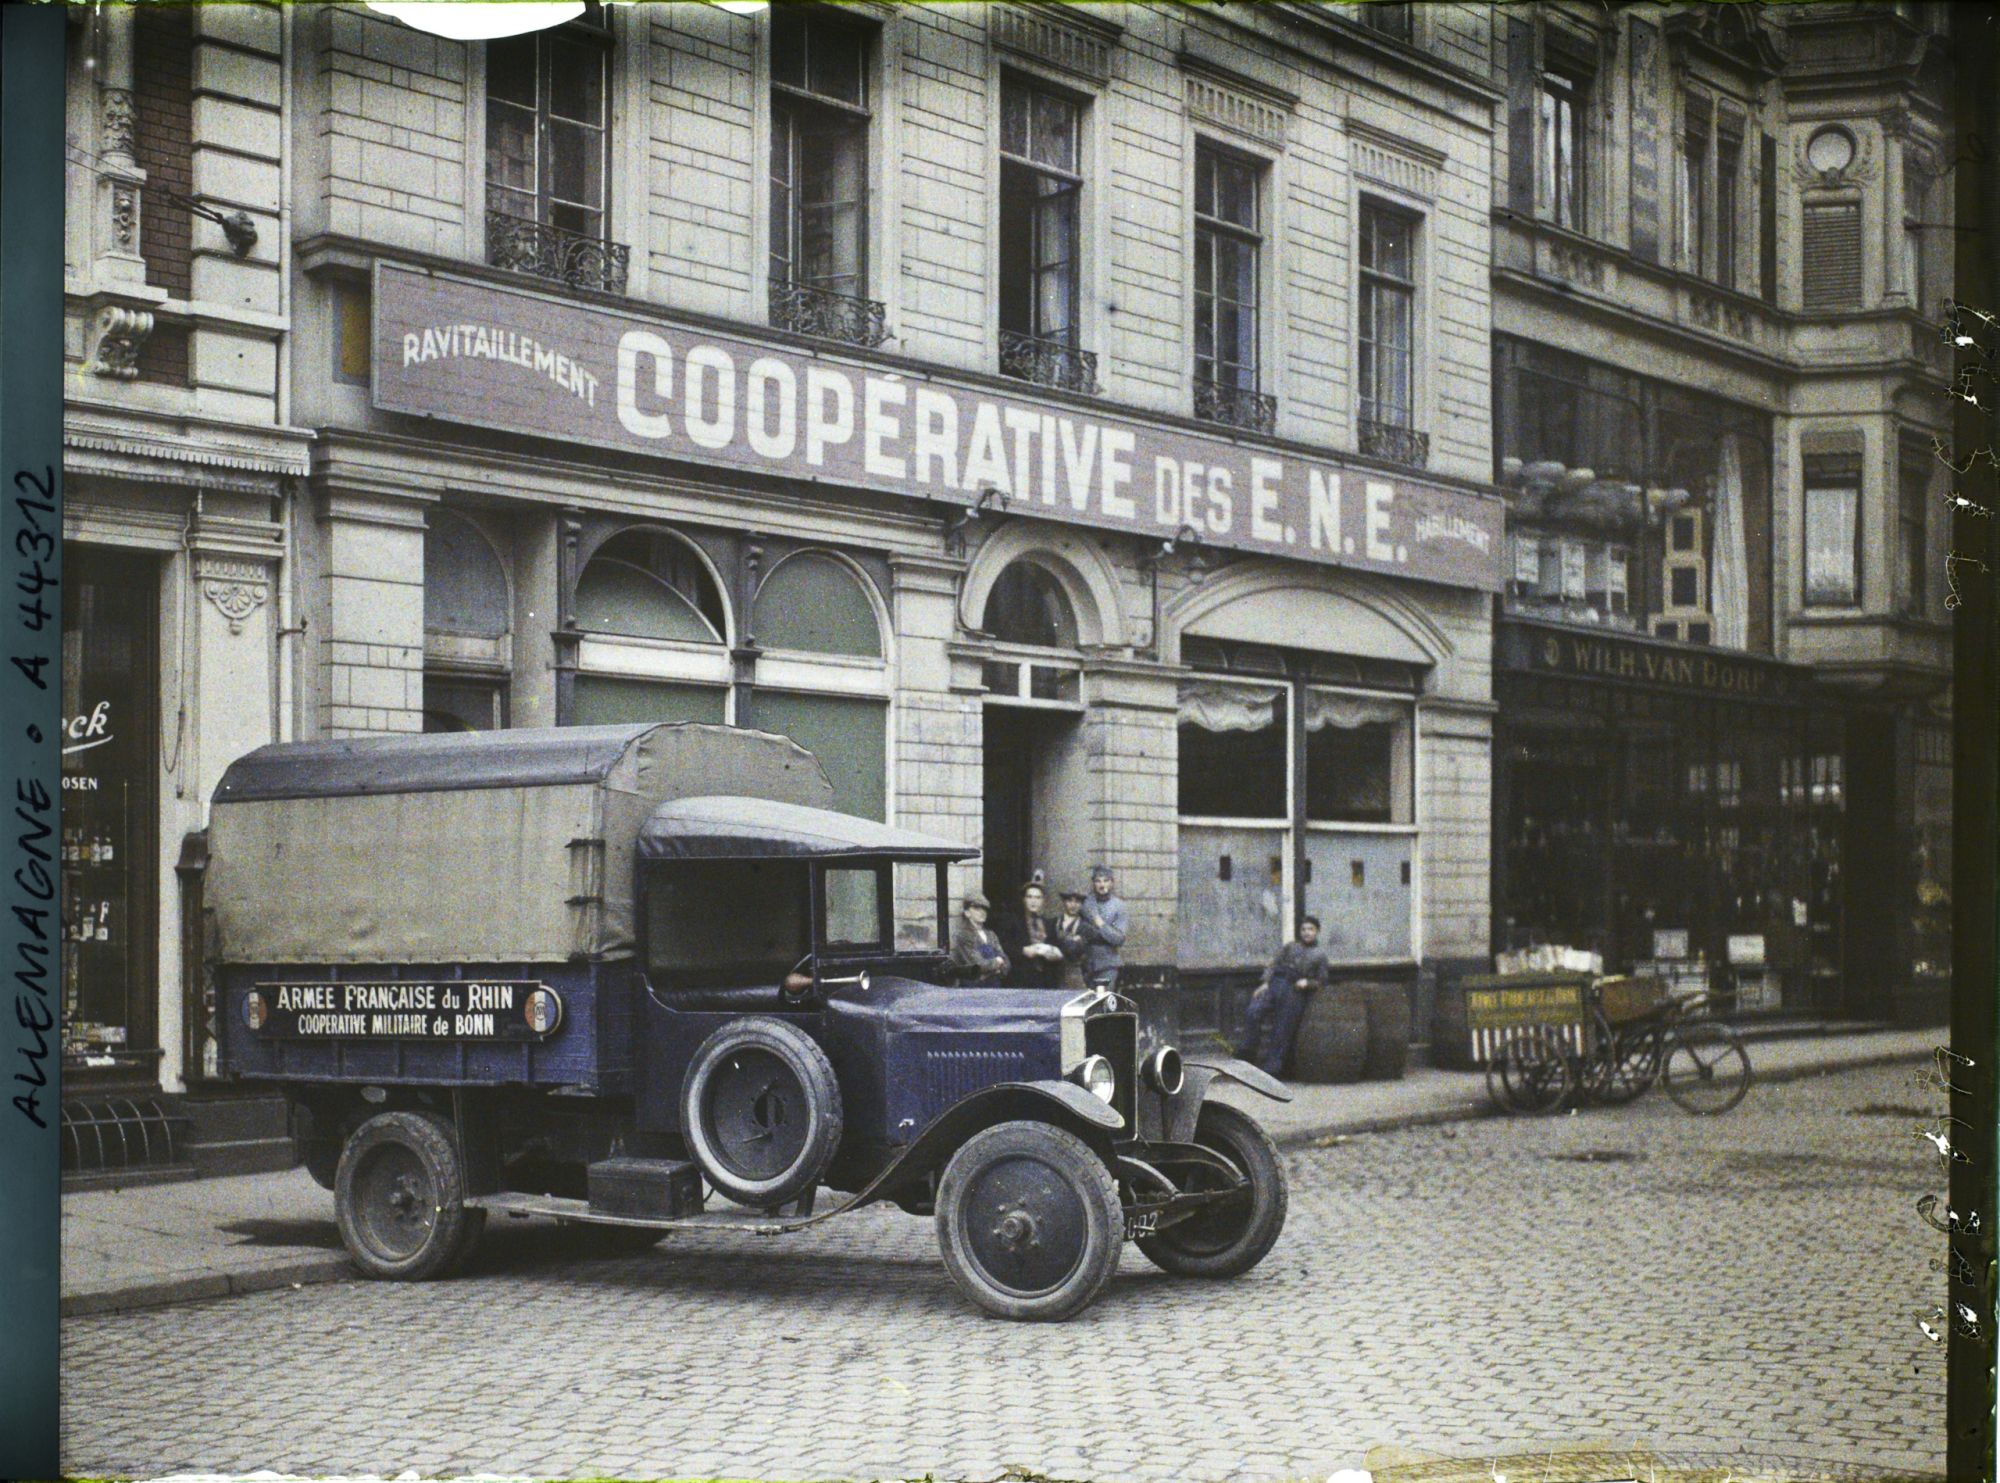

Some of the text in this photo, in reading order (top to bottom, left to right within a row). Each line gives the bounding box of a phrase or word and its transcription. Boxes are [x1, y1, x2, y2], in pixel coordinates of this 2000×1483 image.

[402, 324, 599, 408] RAVITAILLEMENT
[616, 330, 1136, 519] COOPÉRATIVE
[1154, 455, 1233, 534] DES
[62, 700, 111, 740] ck
[10, 464, 59, 1129] ALLEMAGNE A 44312
[344, 984, 437, 1012] FRANÇAISE
[441, 988, 461, 1010] du
[466, 983, 514, 1012] RHIN
[371, 1014, 428, 1035] MILITAIRE
[432, 1015, 449, 1036] de
[455, 1013, 495, 1036] BONN
